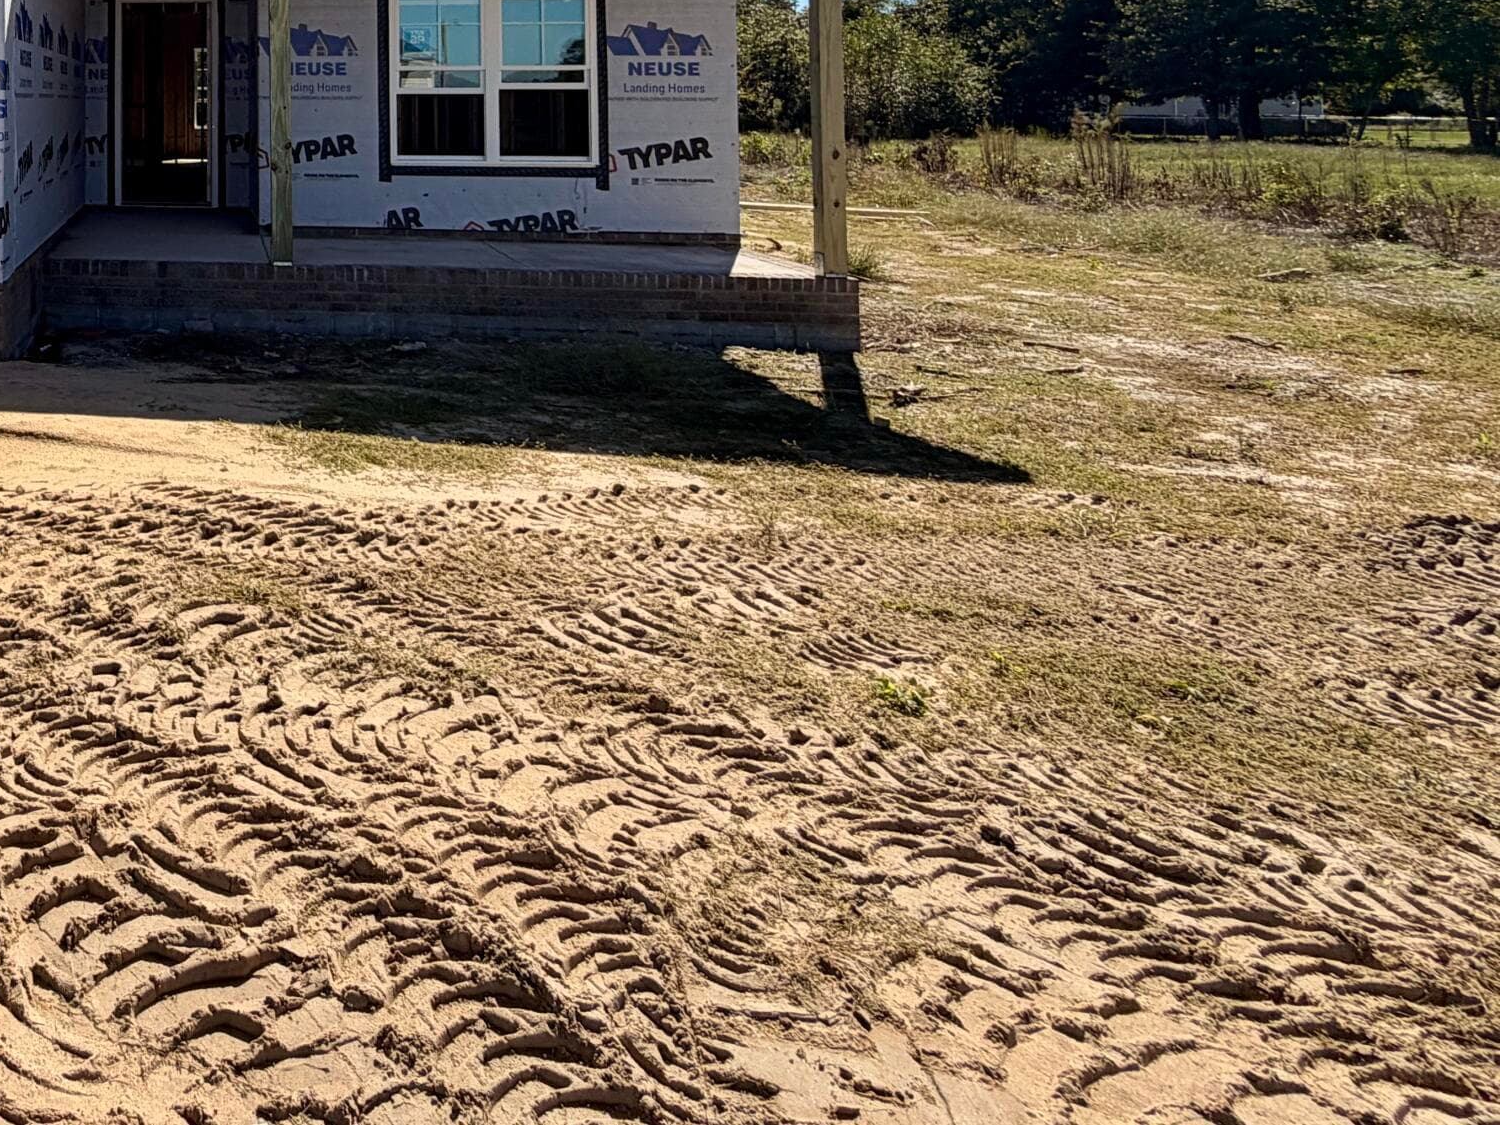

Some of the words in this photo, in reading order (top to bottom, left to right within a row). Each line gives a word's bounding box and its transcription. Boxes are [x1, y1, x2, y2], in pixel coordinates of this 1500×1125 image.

[628, 62, 700, 76] NEUSE
[291, 82, 314, 94] ding
[318, 82, 352, 92] Homes
[624, 83, 665, 95] Landing
[668, 84, 706, 94] Homes
[292, 134, 358, 164] YPAR
[618, 137, 713, 170] TYPAR
